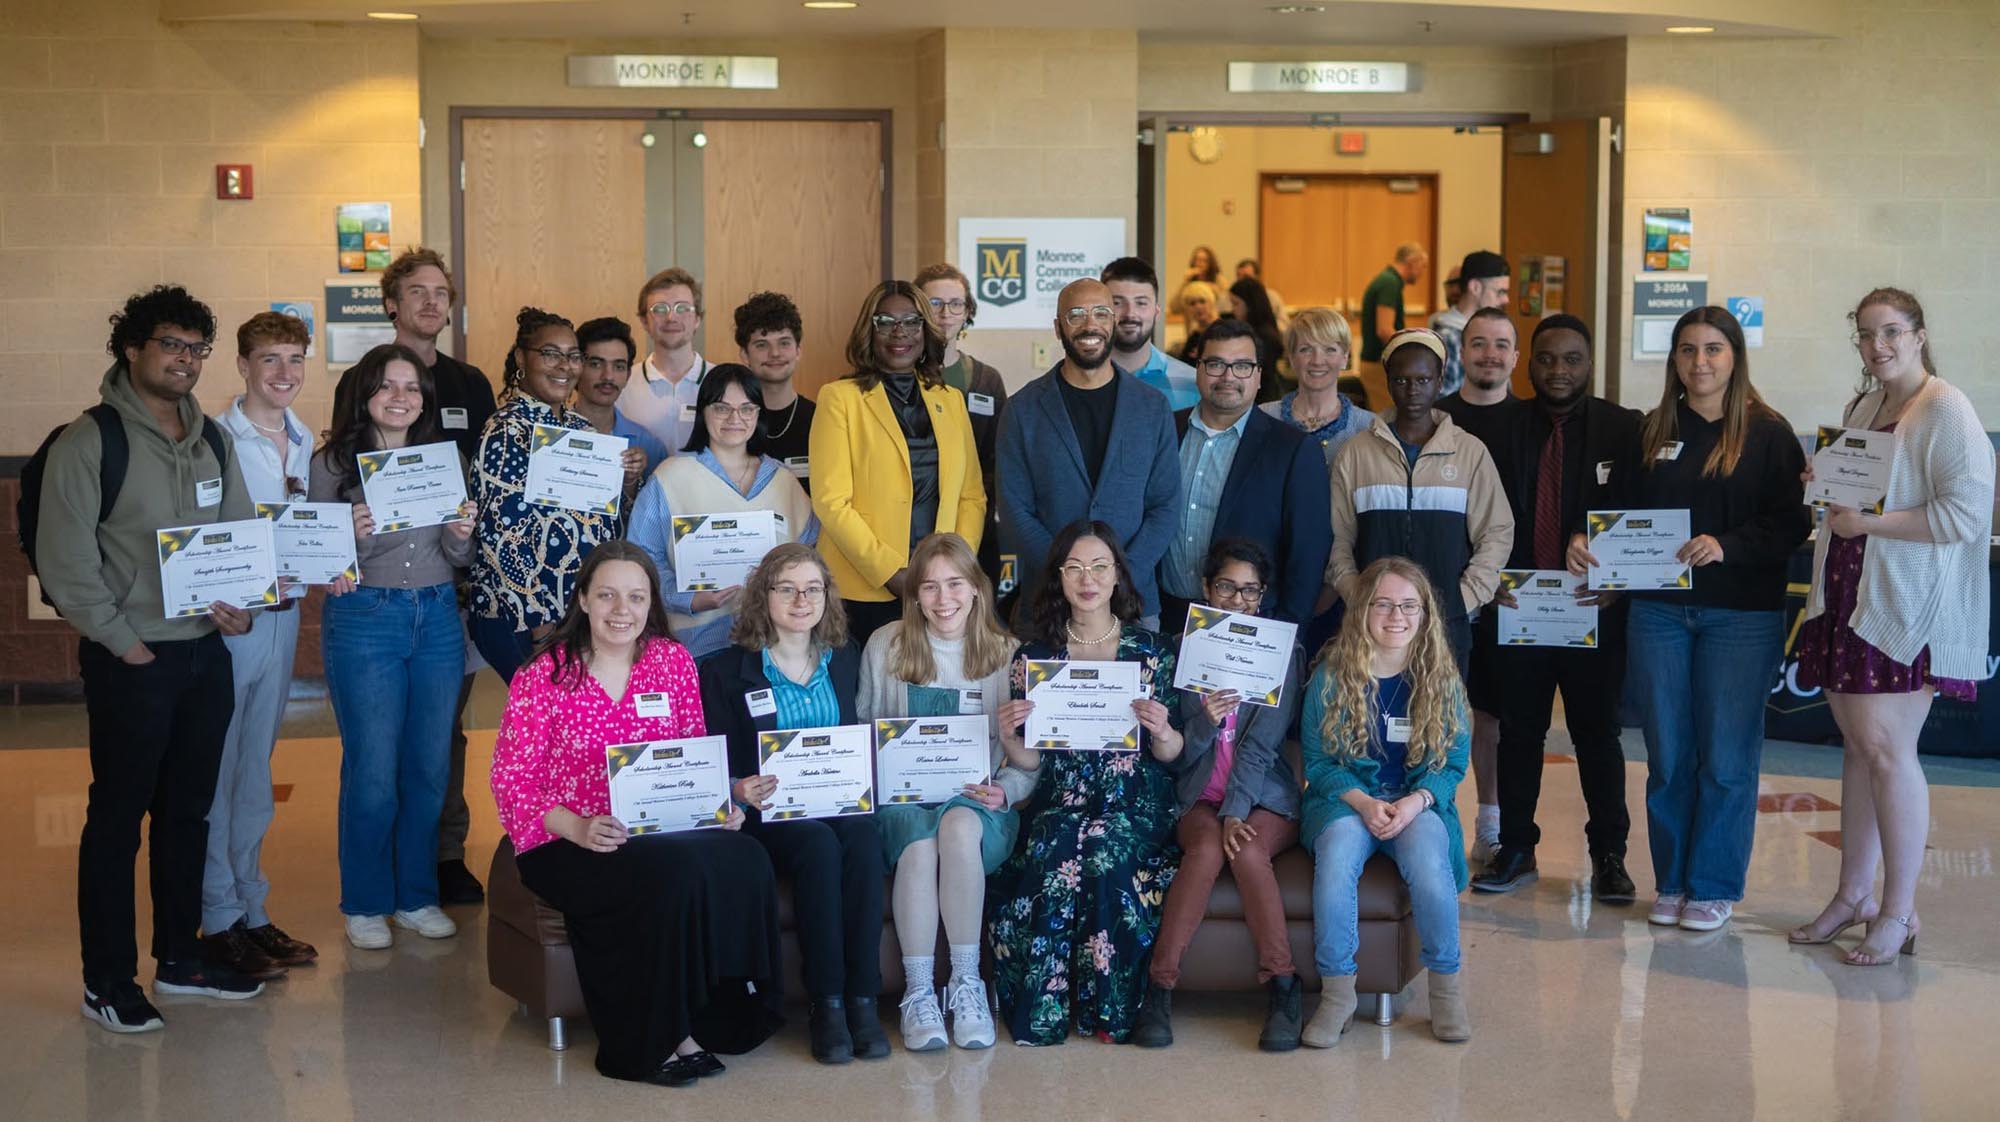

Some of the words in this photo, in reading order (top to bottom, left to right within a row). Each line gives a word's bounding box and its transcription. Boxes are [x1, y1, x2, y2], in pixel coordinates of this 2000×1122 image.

[618, 62, 704, 80] MONROE
[714, 64, 727, 80] A
[1280, 68, 1359, 85] MONROE
[1369, 68, 1380, 84] B
[1037, 250, 1086, 262] Monroe
[1654, 284, 1688, 293] 3-205A
[1648, 300, 1684, 308] MONROE
[342, 305, 384, 314] MONROE
[634, 764, 661, 773] Scholarship
